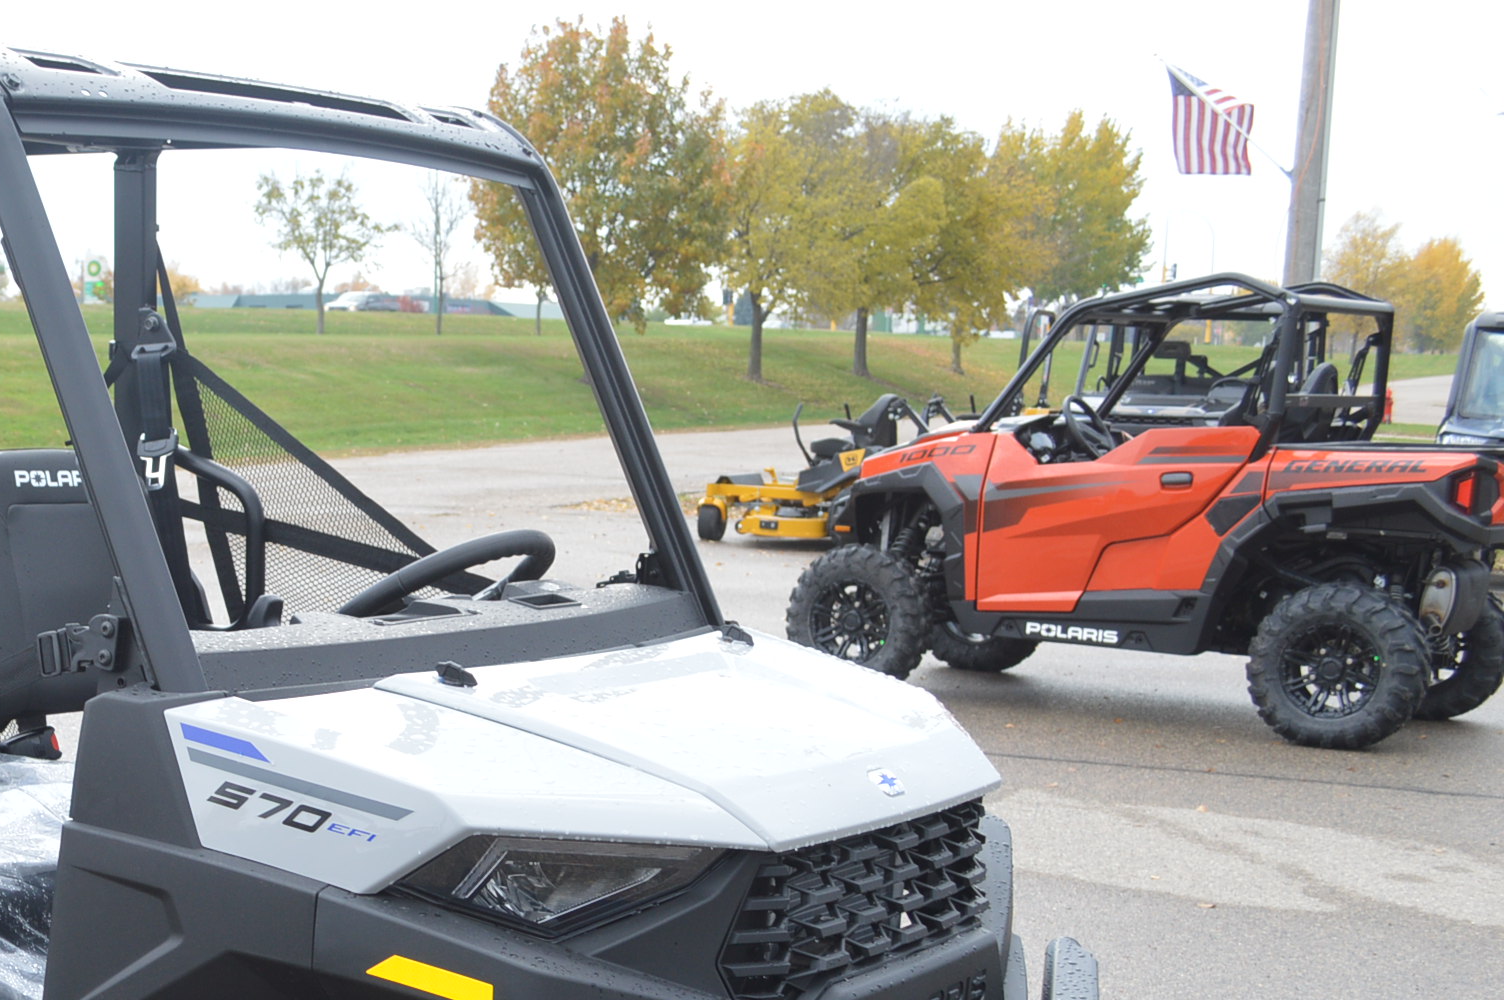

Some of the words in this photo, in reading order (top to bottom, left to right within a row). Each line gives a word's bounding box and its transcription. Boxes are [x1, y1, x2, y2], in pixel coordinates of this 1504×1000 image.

[900, 445, 976, 463] 1000
[1283, 460, 1427, 473] GENERAL
[13, 470, 82, 487] POLAR
[1025, 621, 1119, 644] POLARIS
[206, 781, 333, 833] 570
[327, 823, 377, 842] EFI
